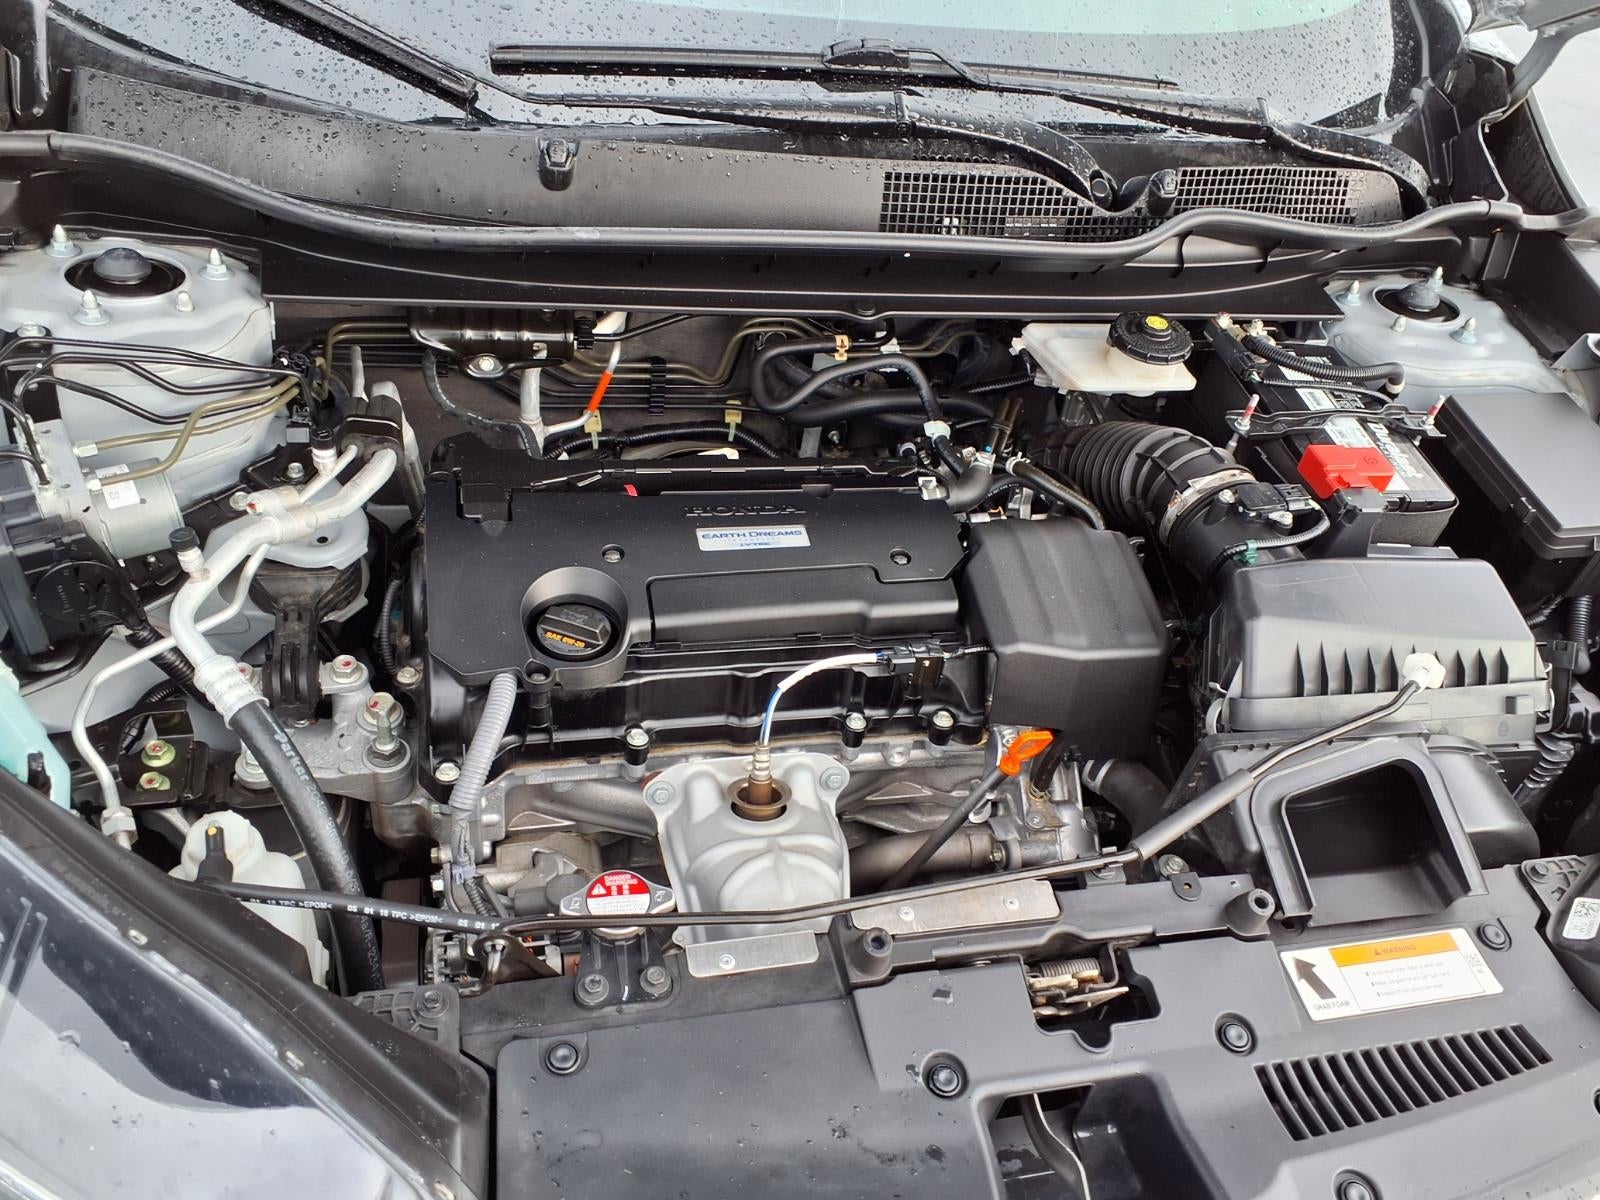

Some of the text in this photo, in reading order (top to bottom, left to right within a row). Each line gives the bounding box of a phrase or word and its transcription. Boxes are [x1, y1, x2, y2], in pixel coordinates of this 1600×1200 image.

[684, 505, 807, 516] HONDA
[701, 531, 746, 540] EARTH
[748, 530, 803, 538] DREAMS
[274, 732, 309, 781] Parker
